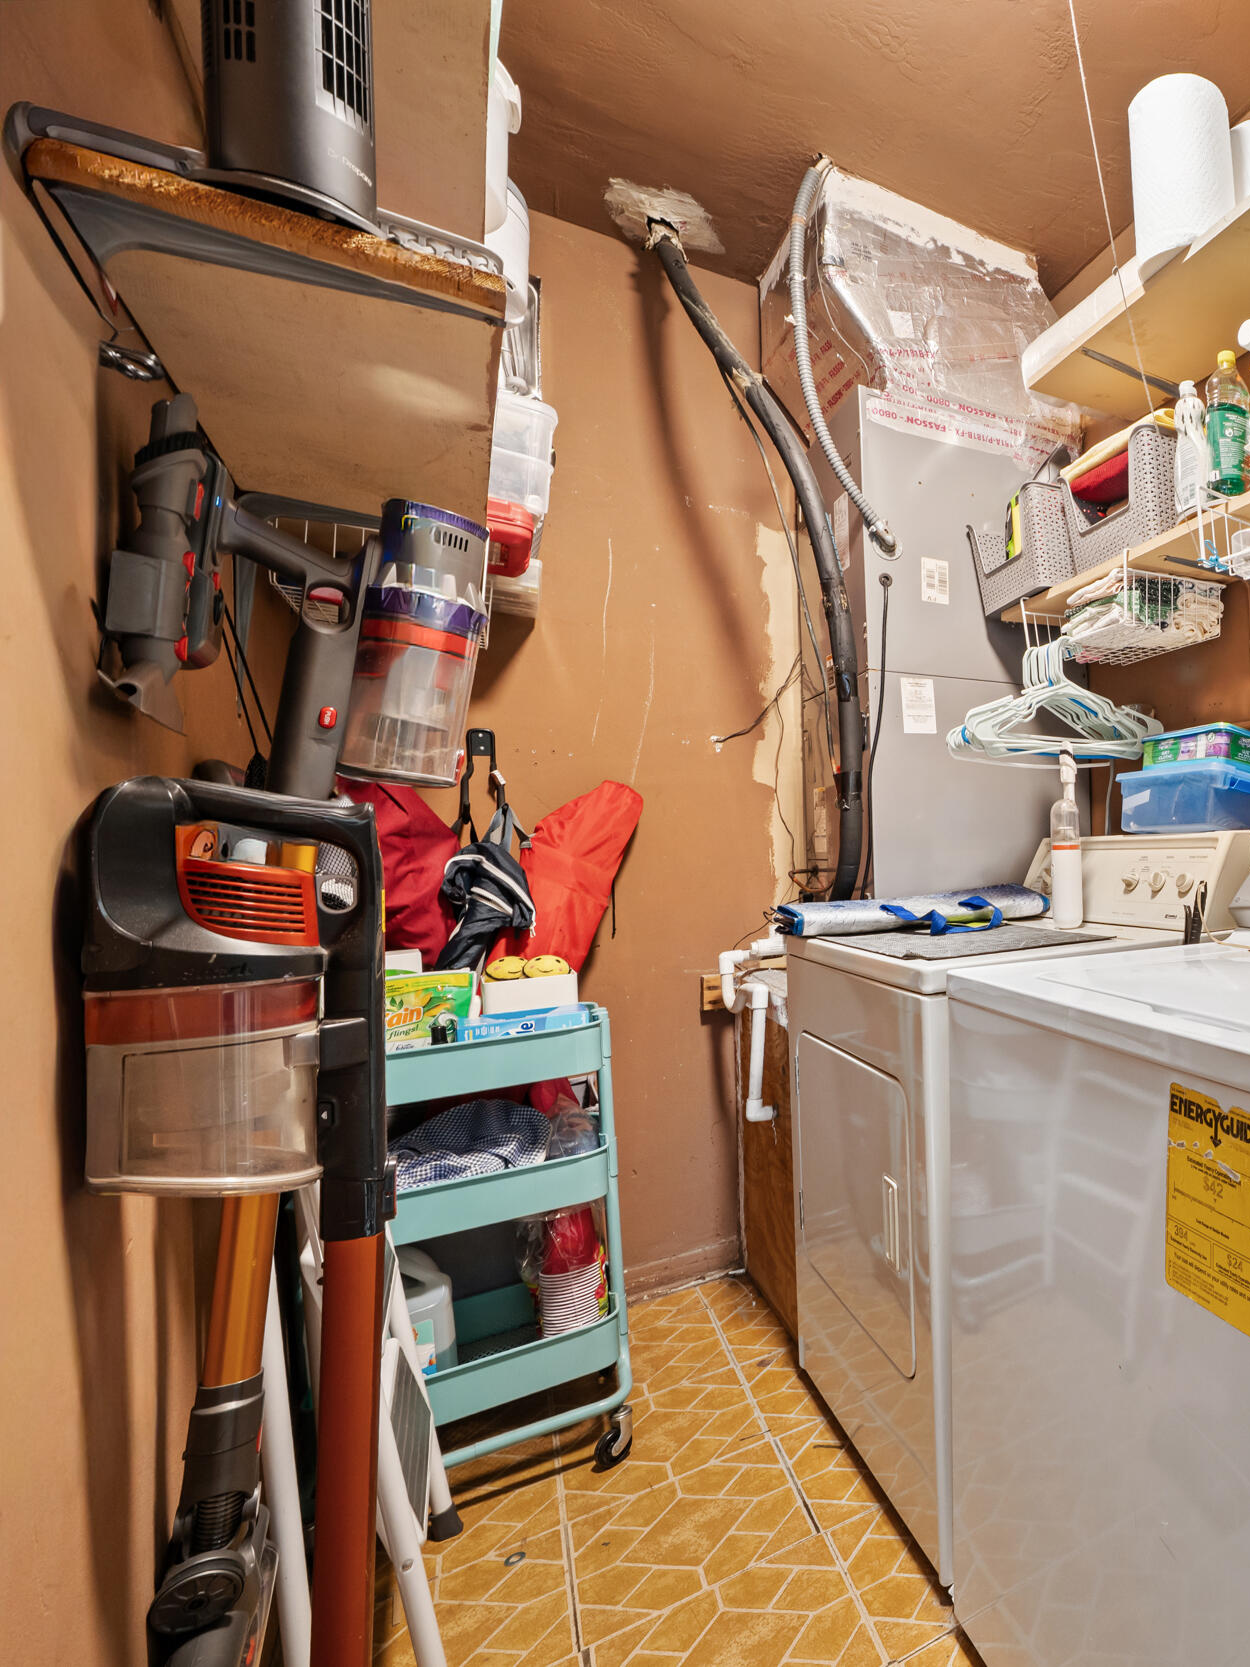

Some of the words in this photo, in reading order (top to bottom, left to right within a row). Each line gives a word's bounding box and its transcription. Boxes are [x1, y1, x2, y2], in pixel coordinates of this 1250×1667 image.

[906, 416, 946, 432] FASSON
[386, 1007, 422, 1028] ain
[387, 1024, 419, 1040] flings!
